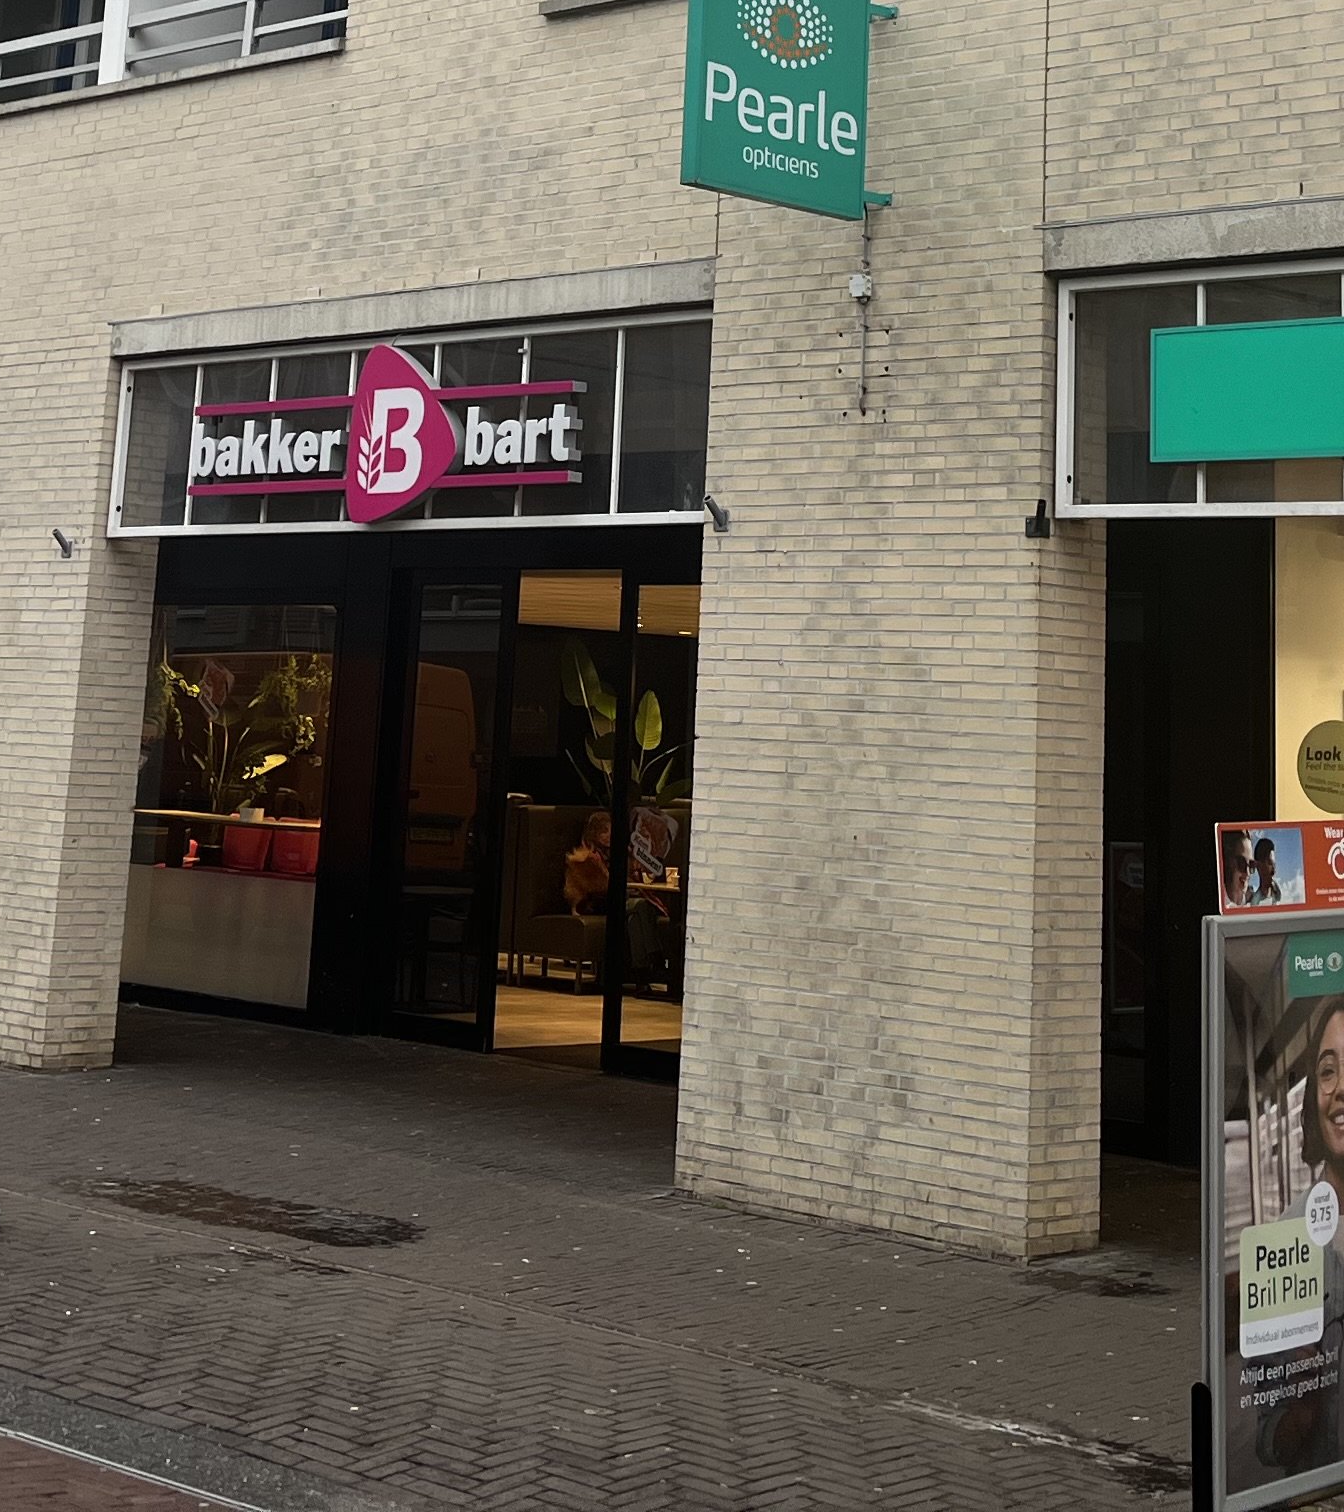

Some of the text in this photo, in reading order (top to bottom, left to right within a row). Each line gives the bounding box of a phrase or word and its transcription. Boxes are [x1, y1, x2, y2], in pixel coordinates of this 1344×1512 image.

[705, 61, 857, 156] Pearle
[743, 145, 819, 179] opticiens
[192, 388, 572, 494] bakker B bart
[1306, 746, 1341, 761] Look
[1324, 827, 1343, 838] Wear
[1295, 954, 1324, 971] Pearle
[1256, 1237, 1310, 1272] Pearle
[1247, 1273, 1318, 1310] Bril Plan
[1240, 1351, 1339, 1386] Altijd een passende bril
[1240, 1369, 1339, 1408] en zorgeloos goed zicht
